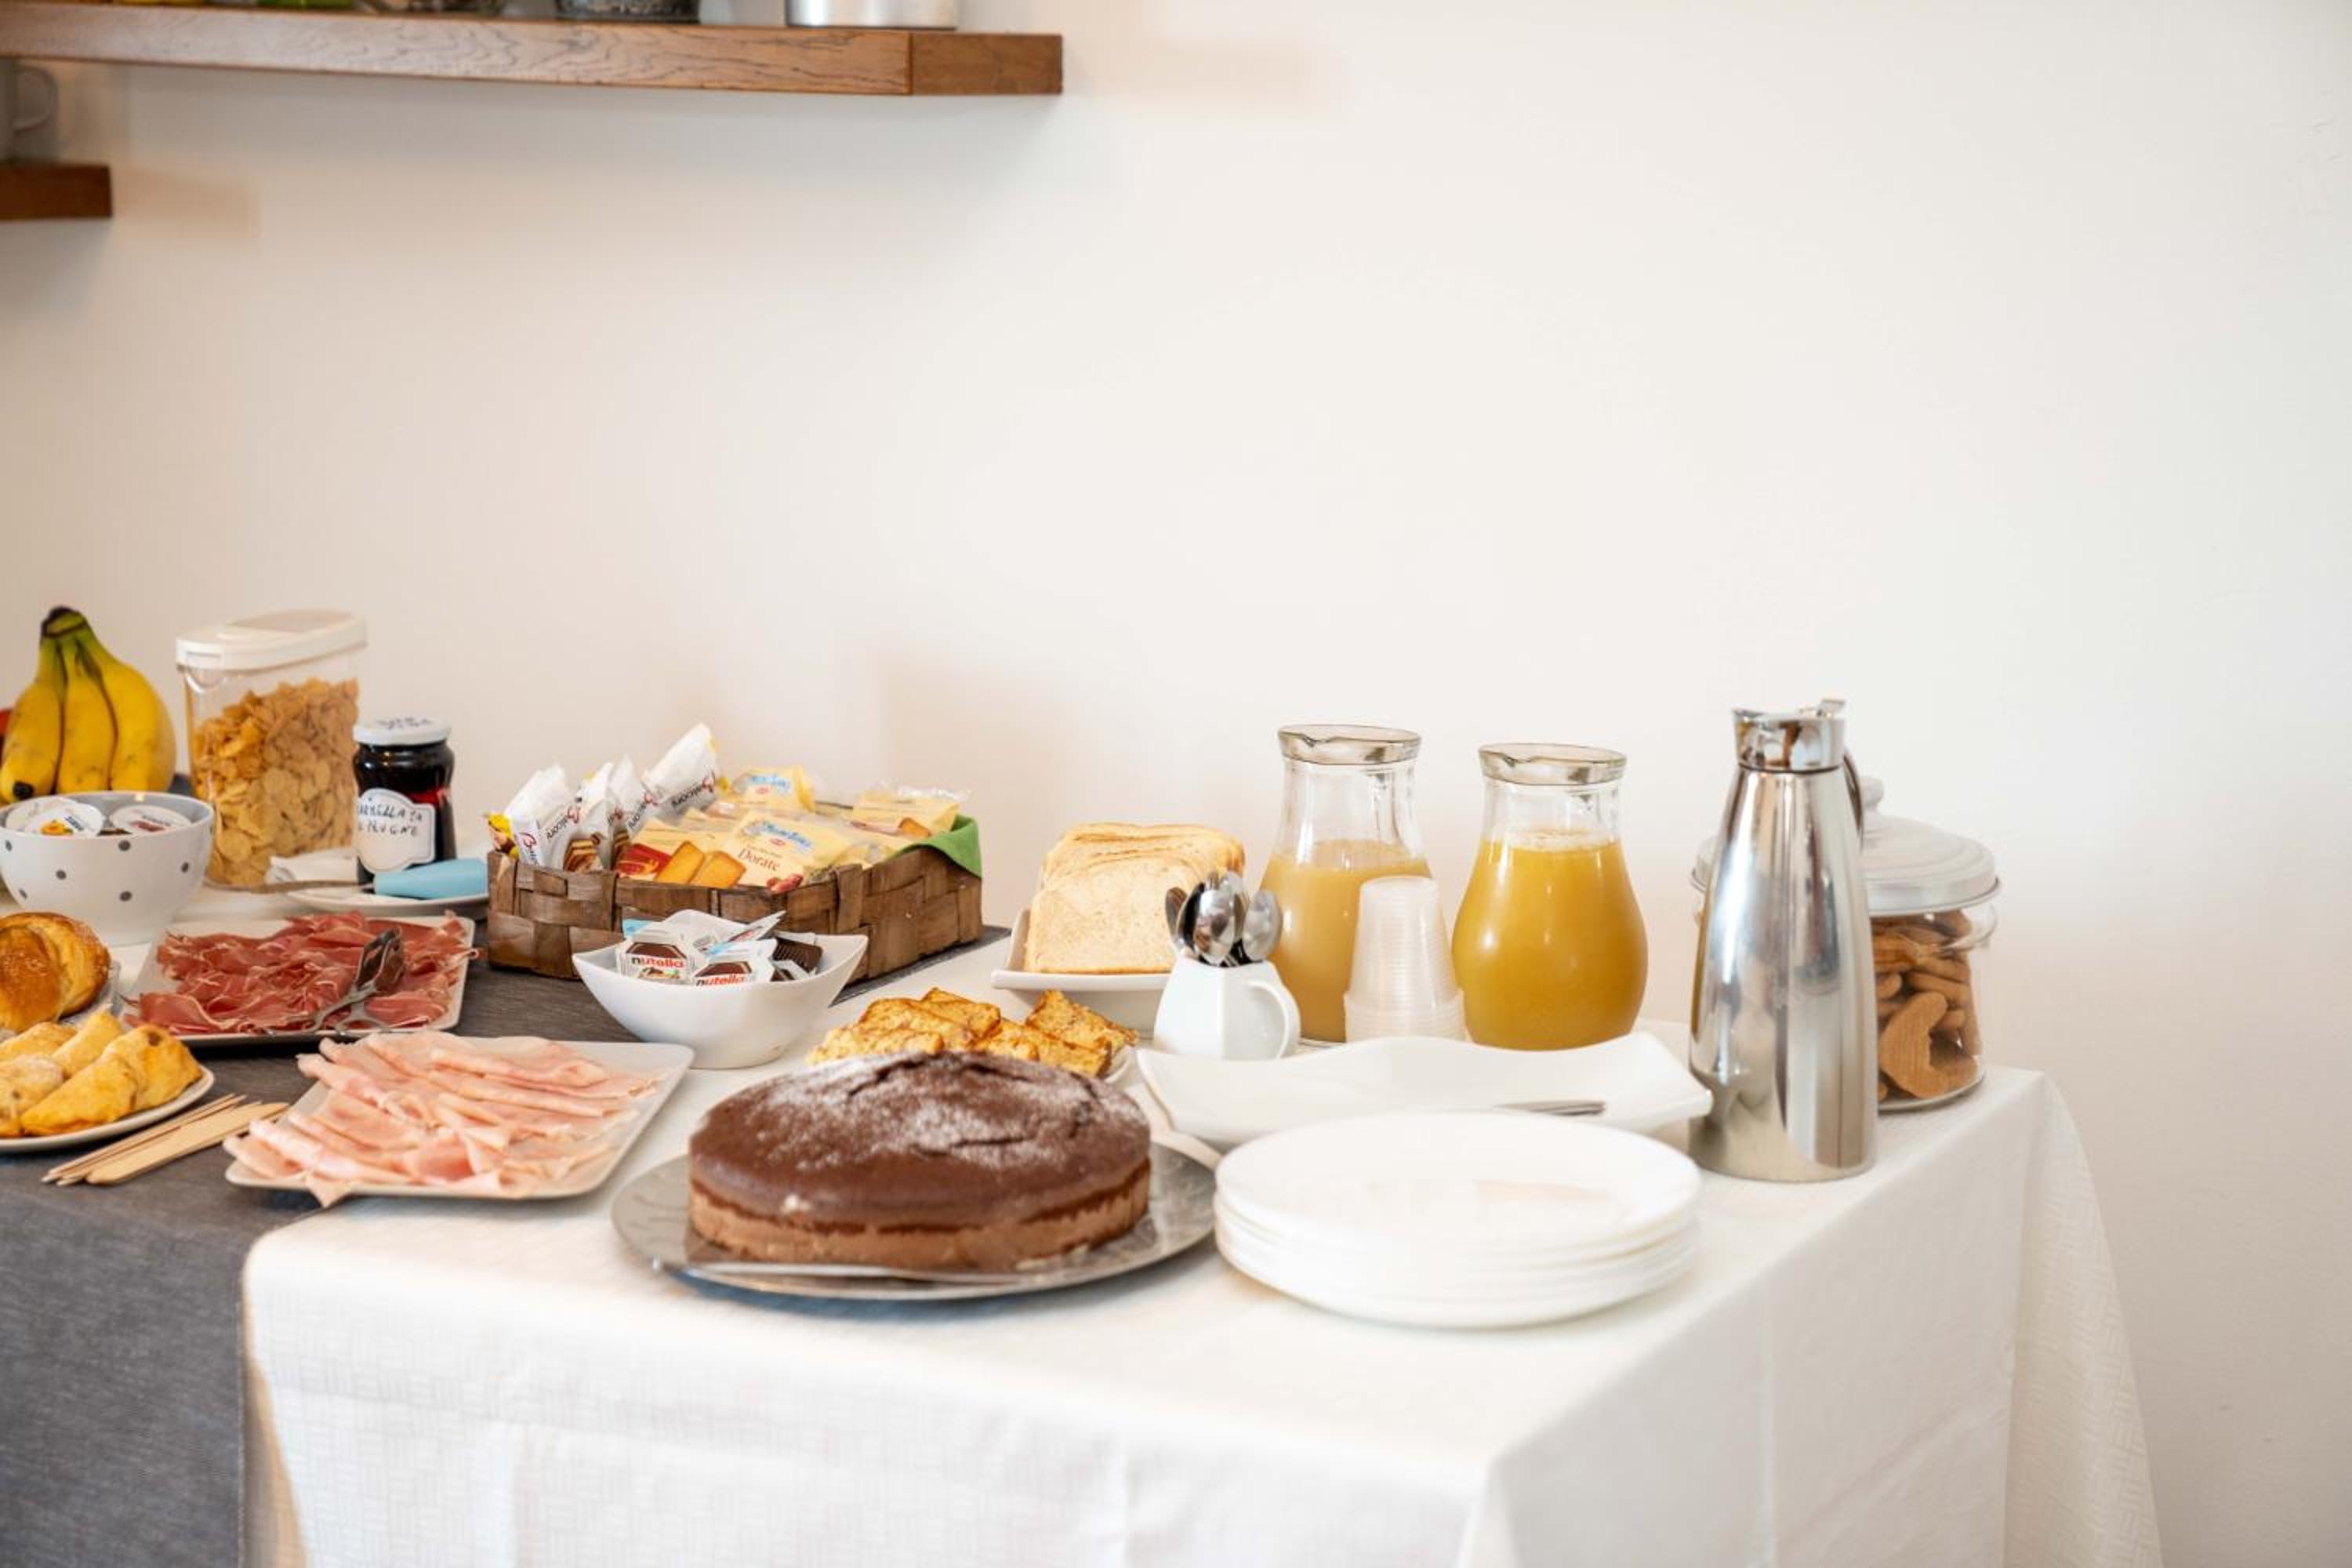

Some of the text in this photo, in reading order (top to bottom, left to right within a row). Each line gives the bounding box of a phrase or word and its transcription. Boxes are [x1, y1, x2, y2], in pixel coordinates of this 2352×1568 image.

[737, 848, 781, 871] Dorate
[632, 957, 685, 968] nutella
[697, 972, 746, 987] nutella
